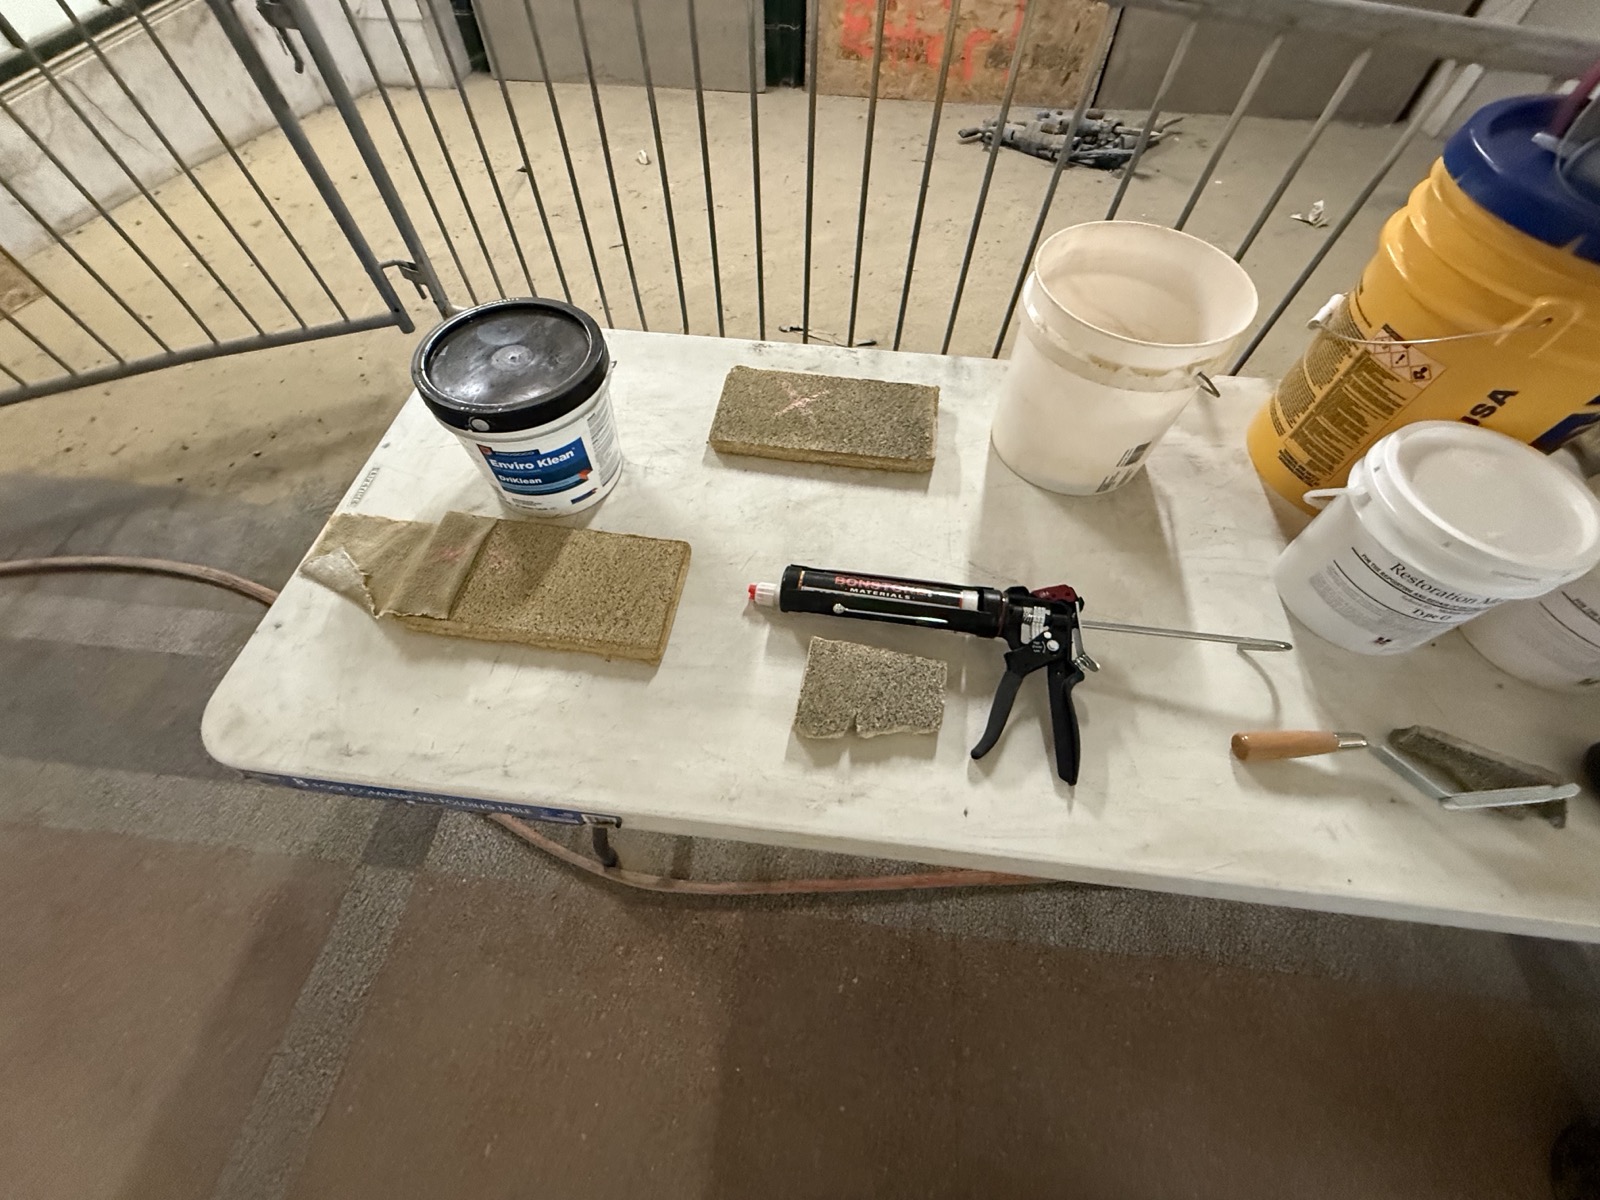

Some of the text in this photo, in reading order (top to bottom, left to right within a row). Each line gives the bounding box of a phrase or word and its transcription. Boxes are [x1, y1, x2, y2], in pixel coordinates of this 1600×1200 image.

[489, 449, 576, 470] Enviro Klean
[498, 474, 543, 485] DriKlean
[1389, 562, 1478, 605] Restoration
[849, 587, 912, 600] MATERIALS
[1412, 607, 1439, 621] Type
